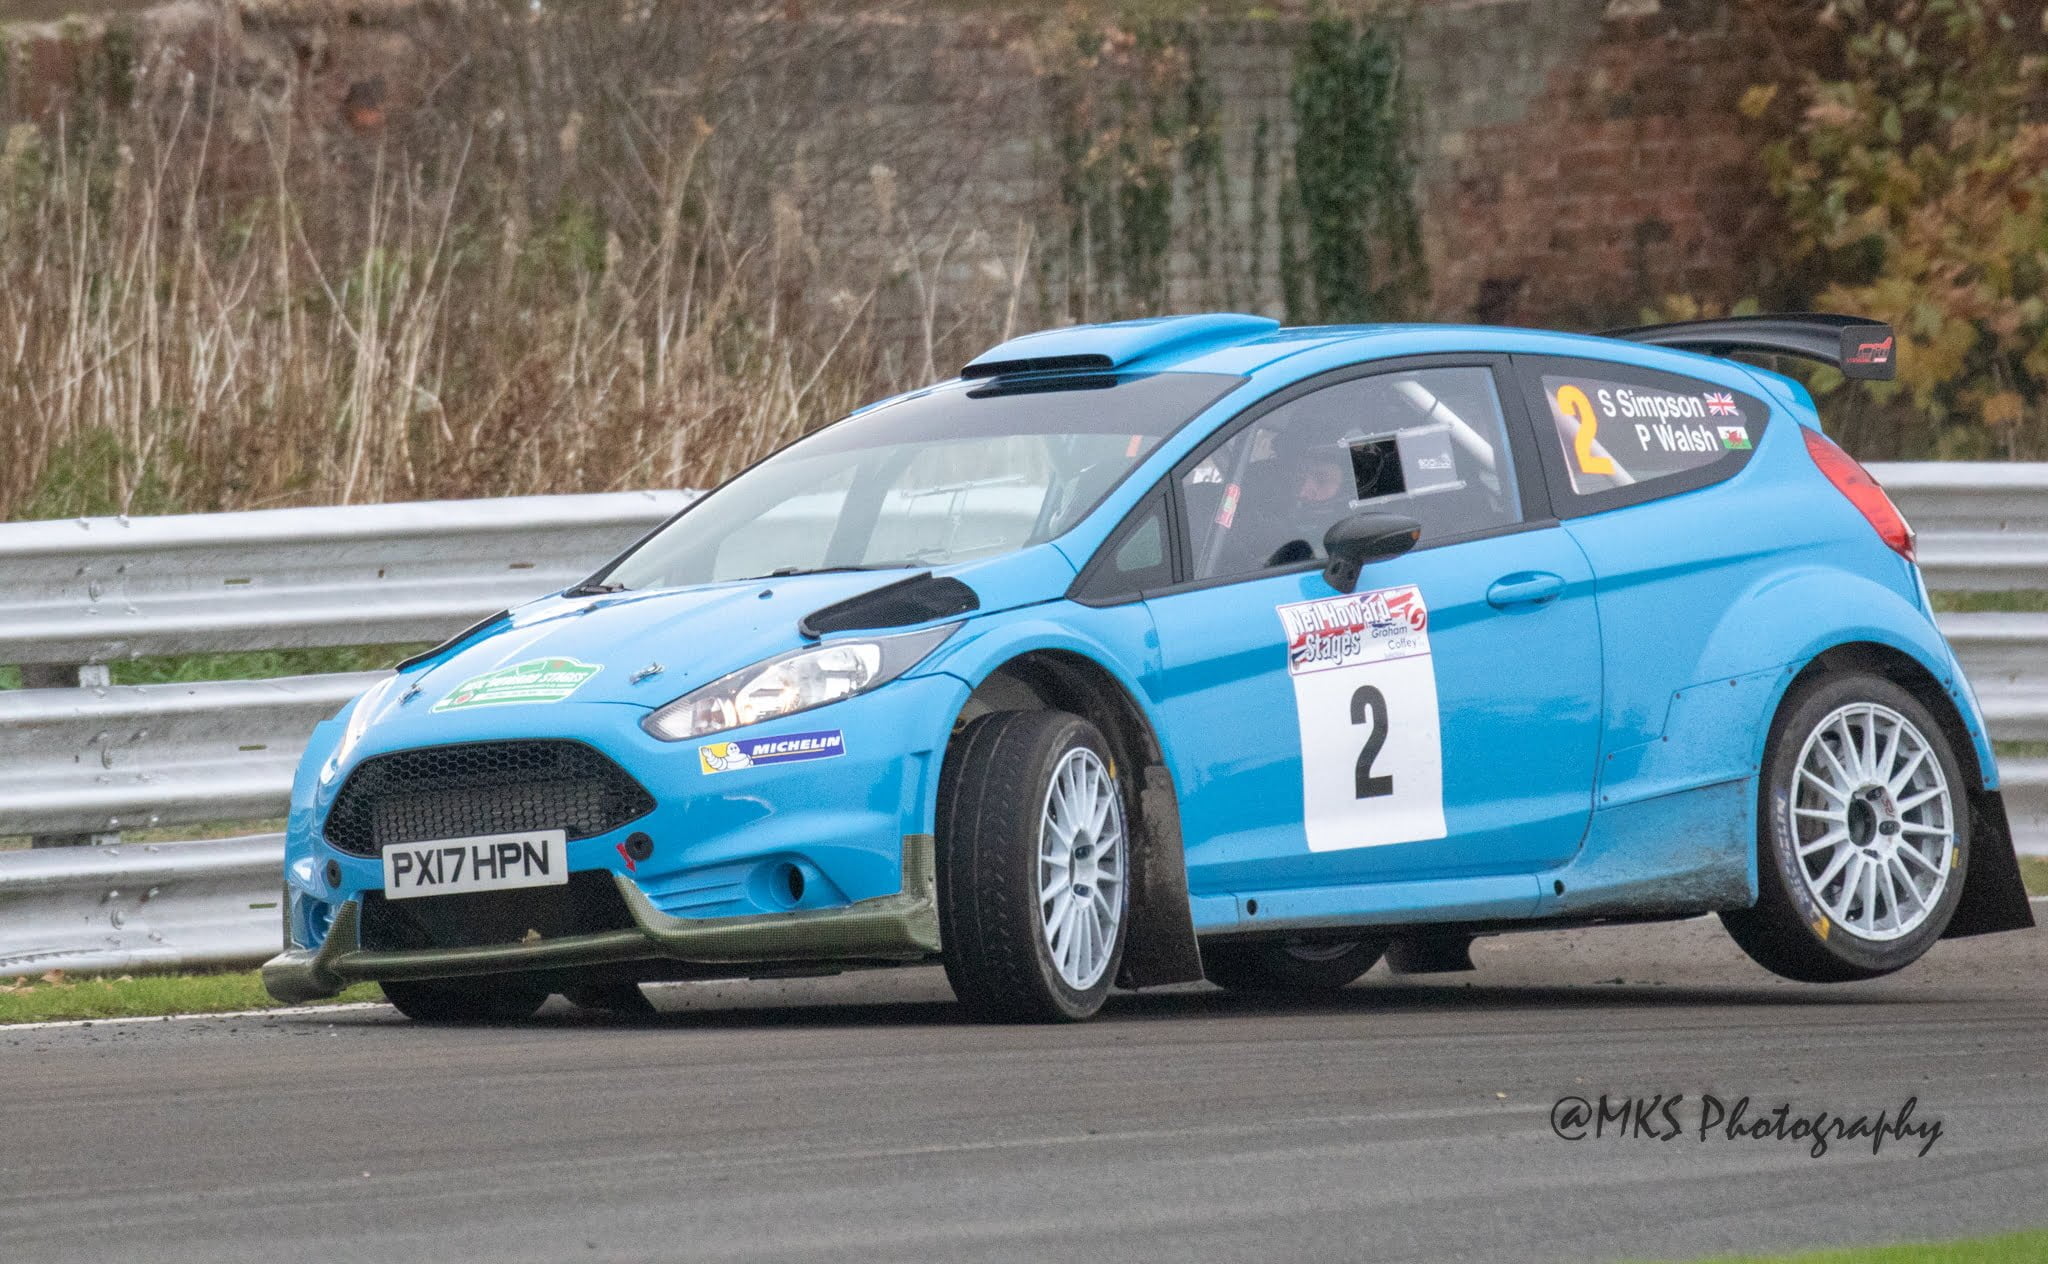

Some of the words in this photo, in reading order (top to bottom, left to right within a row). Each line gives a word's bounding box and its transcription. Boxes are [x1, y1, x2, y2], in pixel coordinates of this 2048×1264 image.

[1597, 389, 1617, 418] S
[1616, 389, 1706, 424] Simpson
[1556, 384, 1616, 476] 2
[1635, 424, 1651, 452] P
[1654, 424, 1719, 452] Walsh
[1287, 605, 1324, 635] Neil
[1323, 594, 1392, 629] Howard
[1371, 625, 1408, 638] Graham
[1305, 632, 1361, 665] Stages
[1388, 638, 1417, 651] Coffey
[752, 736, 841, 756] MICHELIN
[1350, 685, 1393, 799] 2
[391, 846, 466, 888] PX17
[471, 840, 550, 881] HPN
